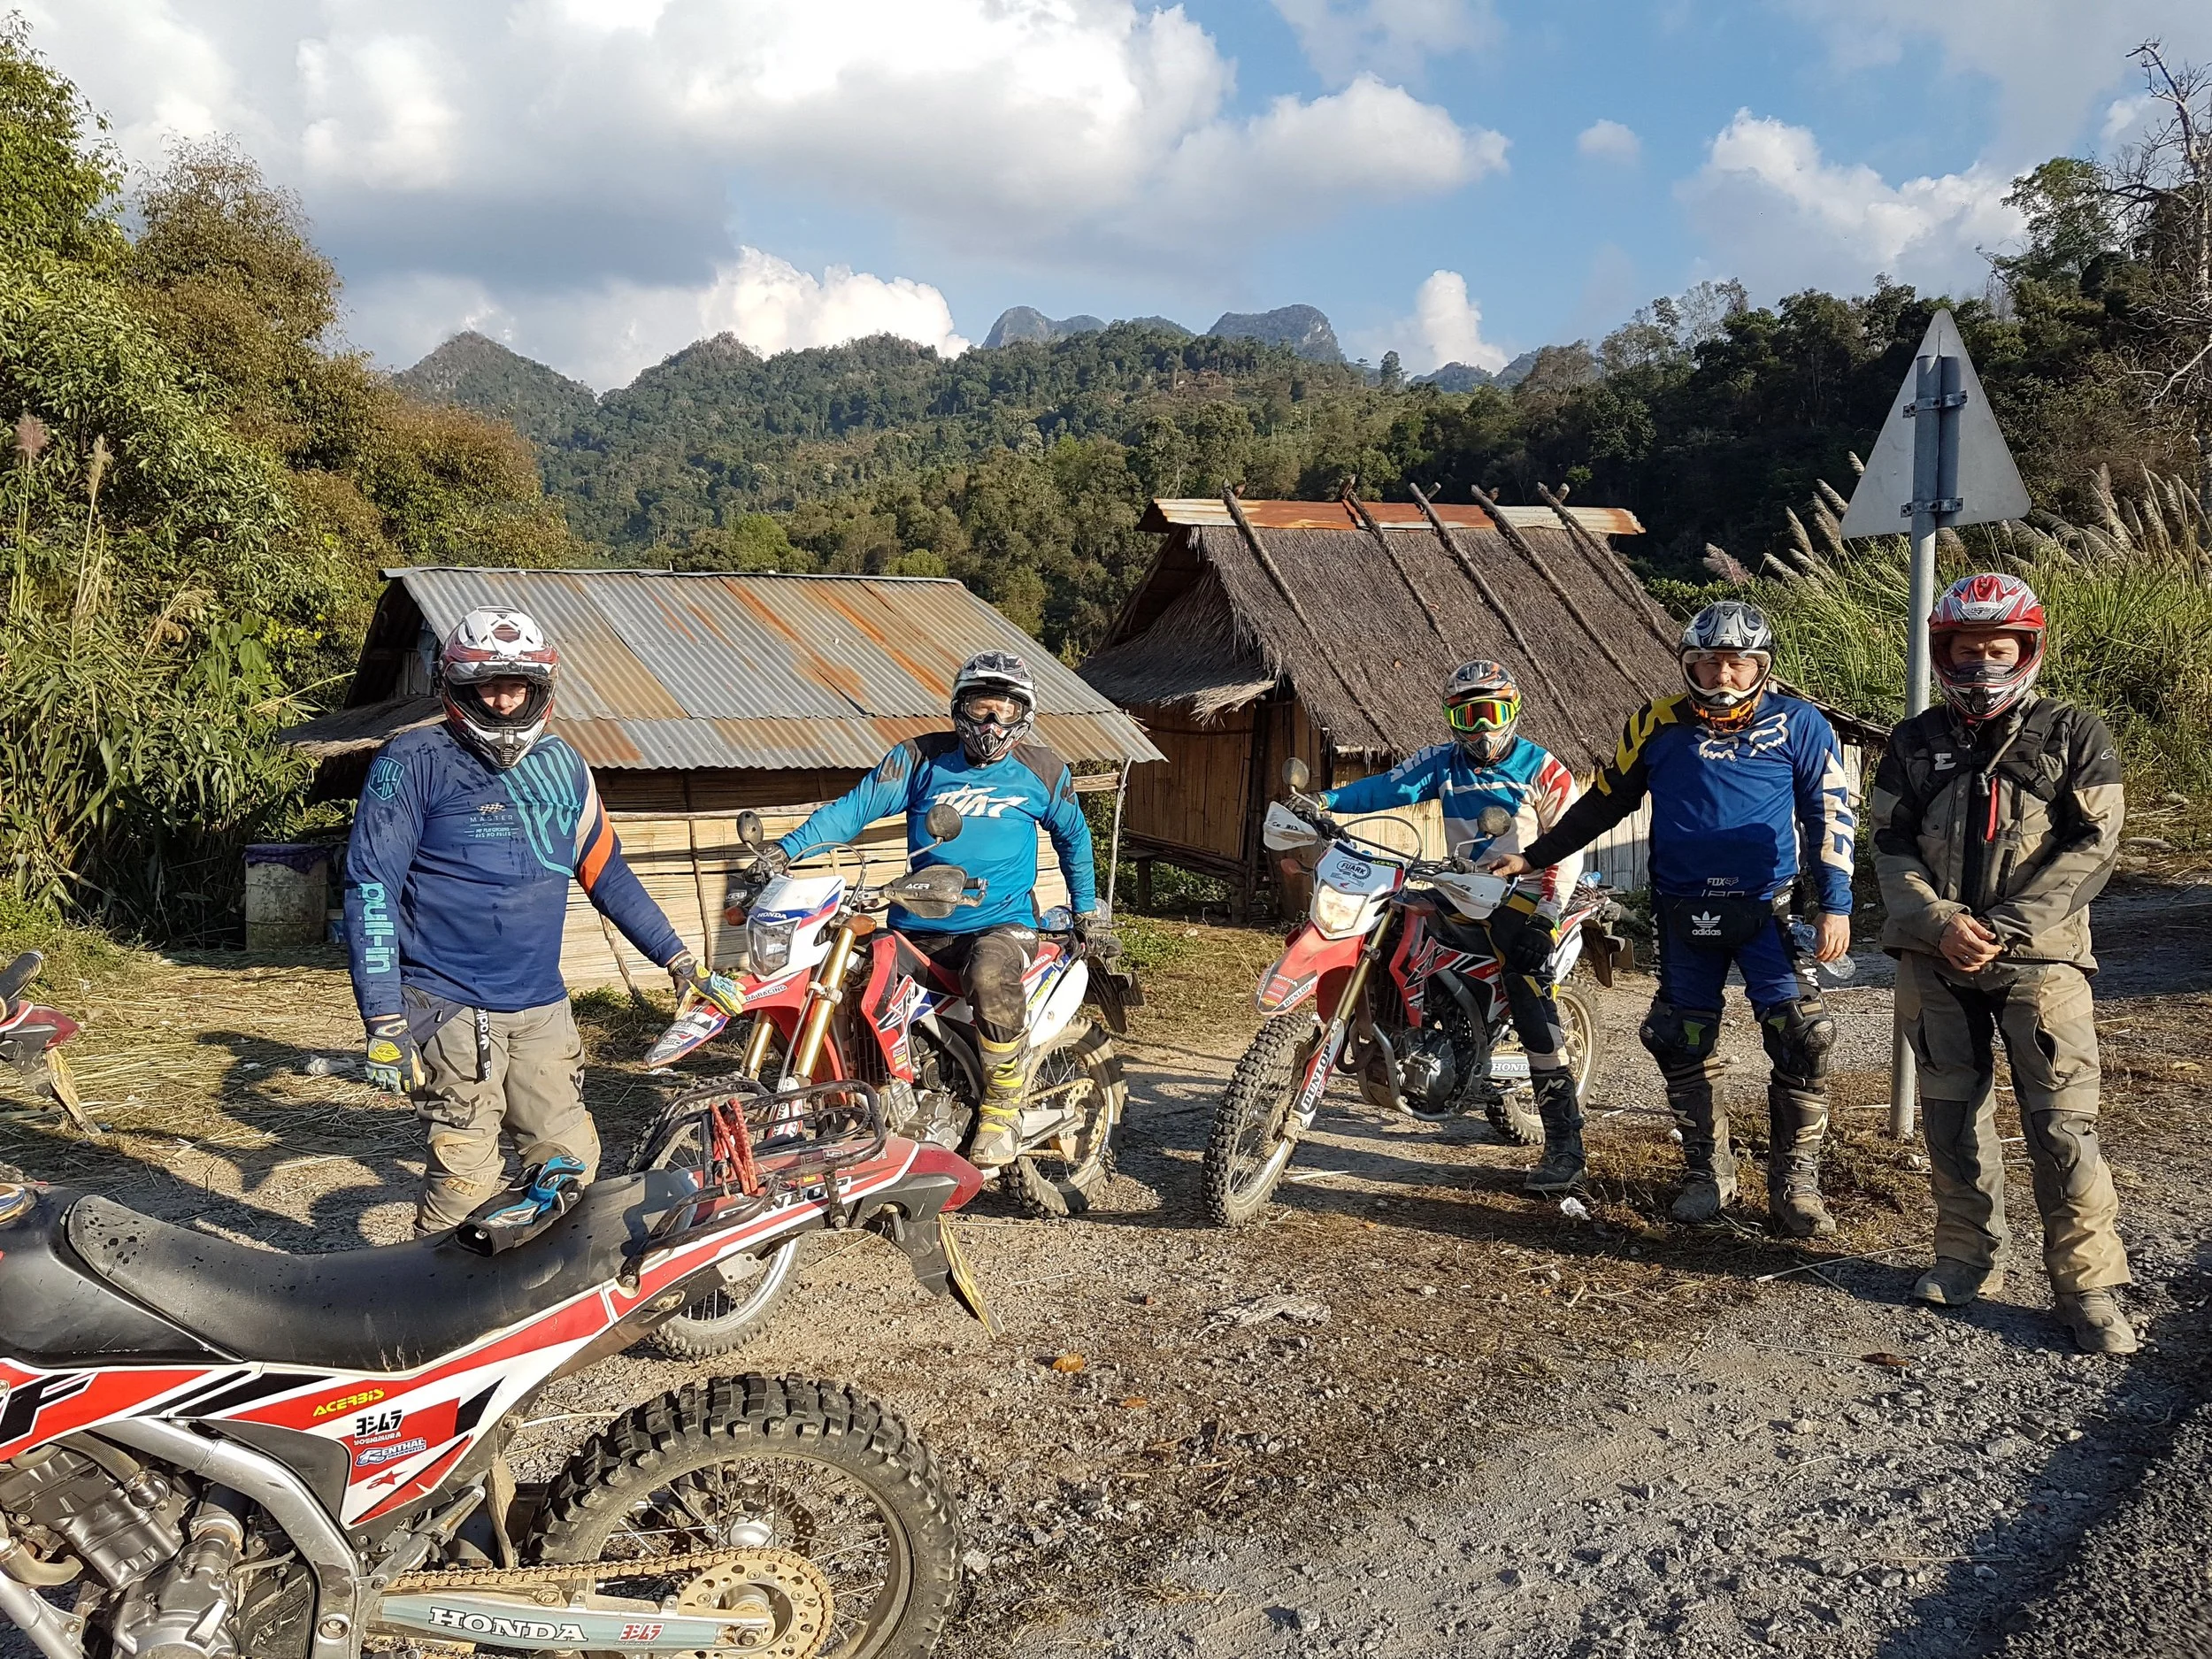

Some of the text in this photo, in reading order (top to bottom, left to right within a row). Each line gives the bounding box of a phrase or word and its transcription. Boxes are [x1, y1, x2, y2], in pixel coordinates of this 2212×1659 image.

[371, 759, 399, 785] PULL
[1707, 877, 1724, 886] FOX
[757, 911, 787, 920] HONDA
[359, 882, 395, 974] pull-in
[1285, 984, 1310, 1006] DUNLOP
[1302, 1044, 1331, 1108] DUNLOP
[1492, 1063, 1529, 1071] HOND
[312, 1388, 385, 1417] ACERBIS
[357, 1409, 402, 1437] ヨシムラ
[354, 1432, 401, 1446] YOSHIMURA
[429, 1606, 588, 1642] HONDA
[620, 1624, 663, 1640] ヨシムラ
